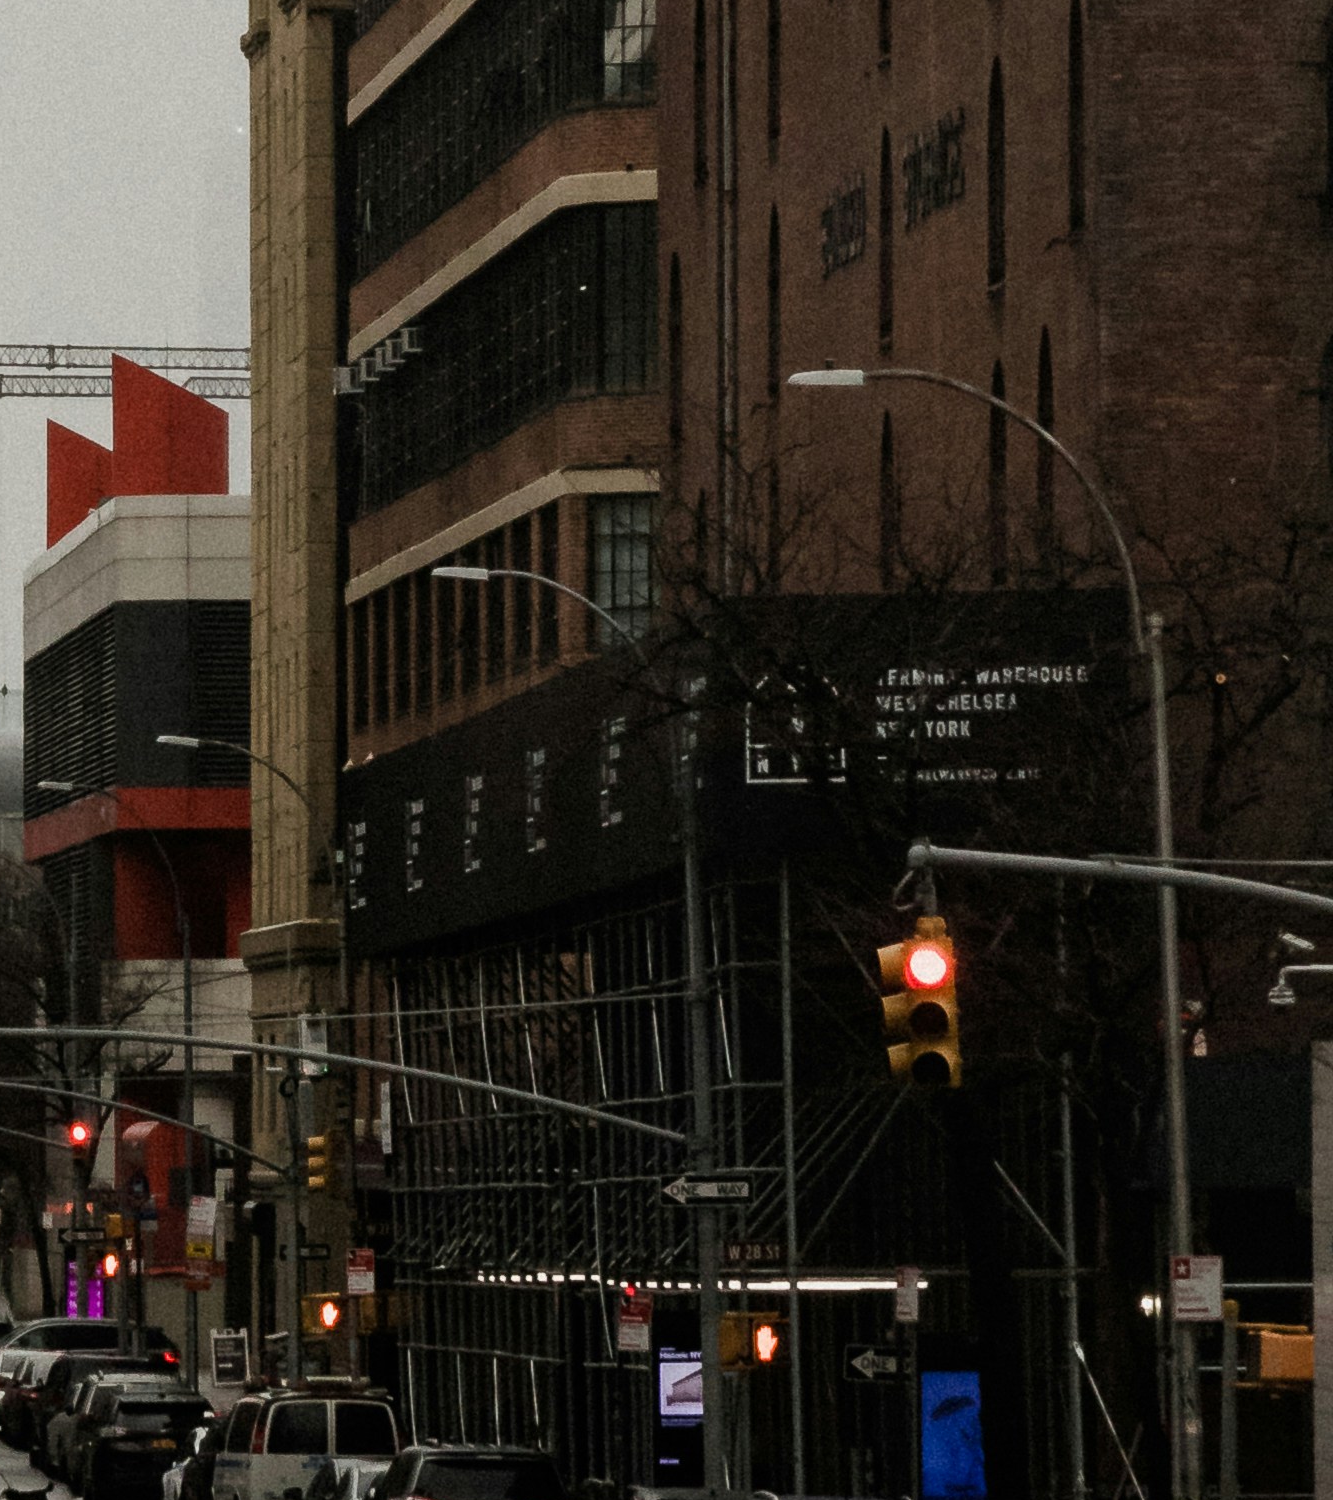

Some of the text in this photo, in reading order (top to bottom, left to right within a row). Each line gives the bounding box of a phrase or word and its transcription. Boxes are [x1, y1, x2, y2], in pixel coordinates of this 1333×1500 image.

[925, 719, 971, 738] YORK
[669, 1182, 744, 1197] ONE WAY
[860, 1355, 890, 1370] ONE
